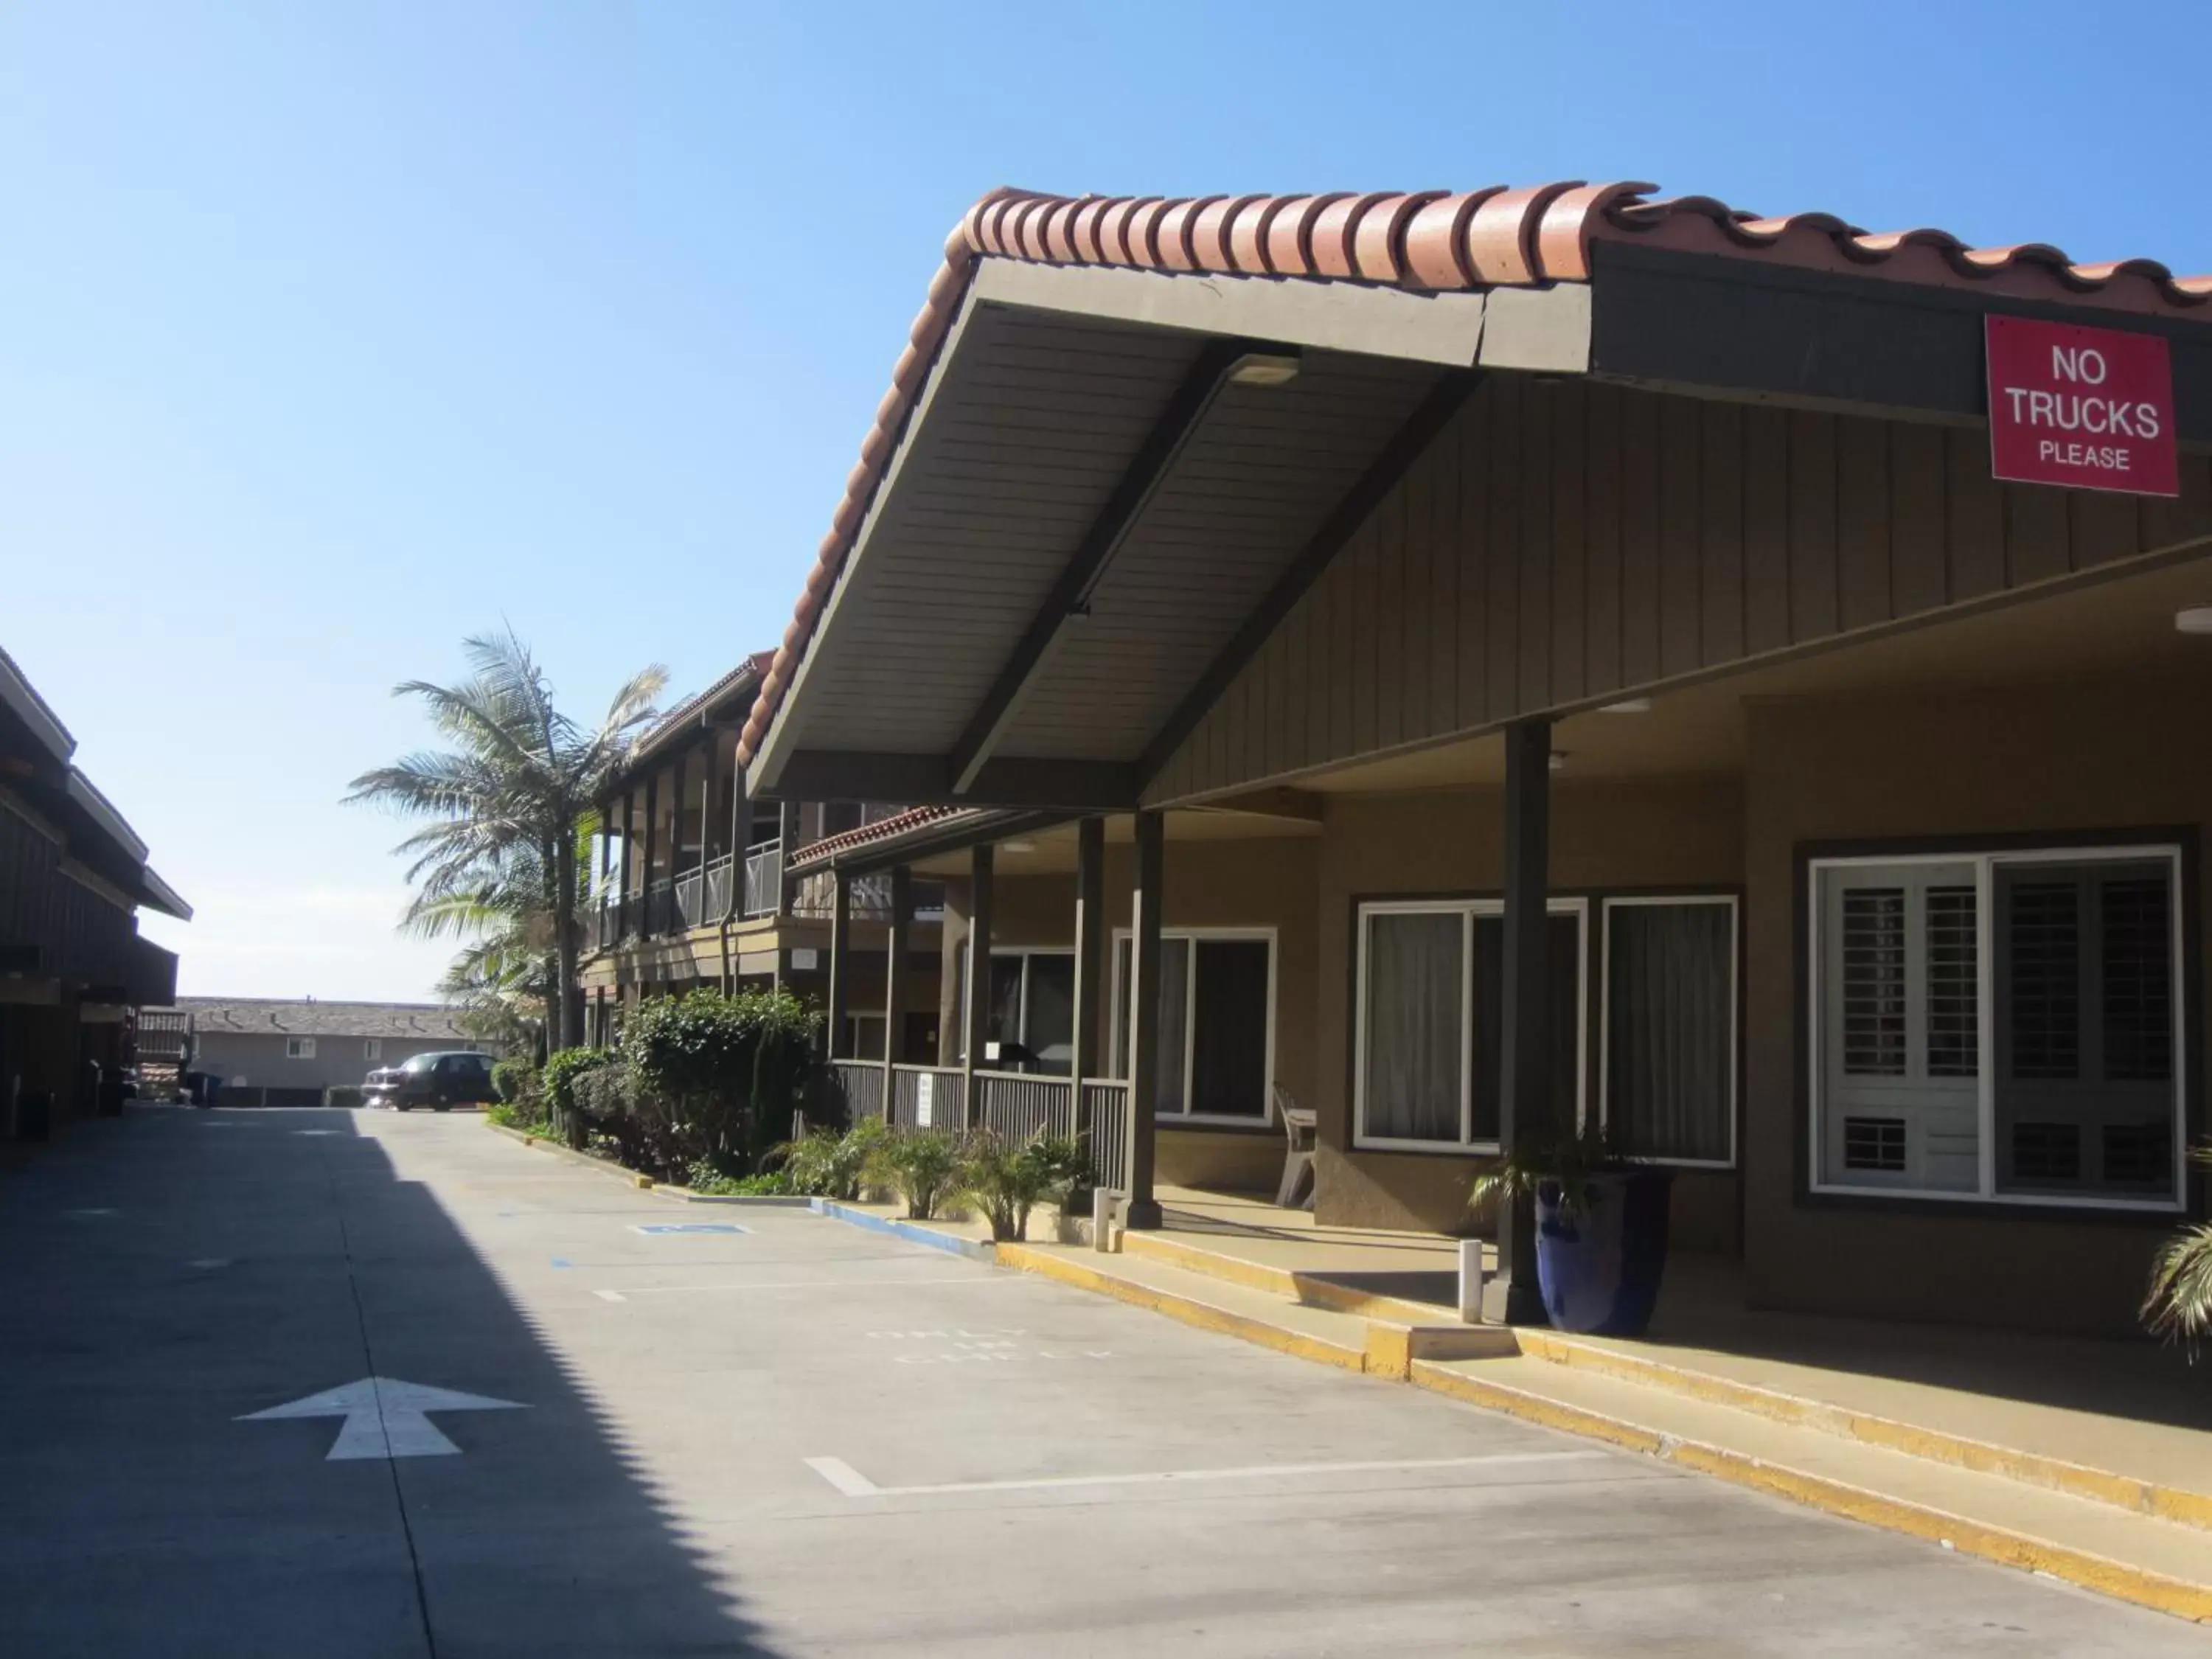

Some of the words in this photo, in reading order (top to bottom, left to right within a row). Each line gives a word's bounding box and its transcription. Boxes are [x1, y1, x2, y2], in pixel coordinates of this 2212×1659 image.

[2052, 345, 2106, 384] NO
[2005, 387, 2159, 439] TRUCKS
[2039, 440, 2130, 470] PLEASE
